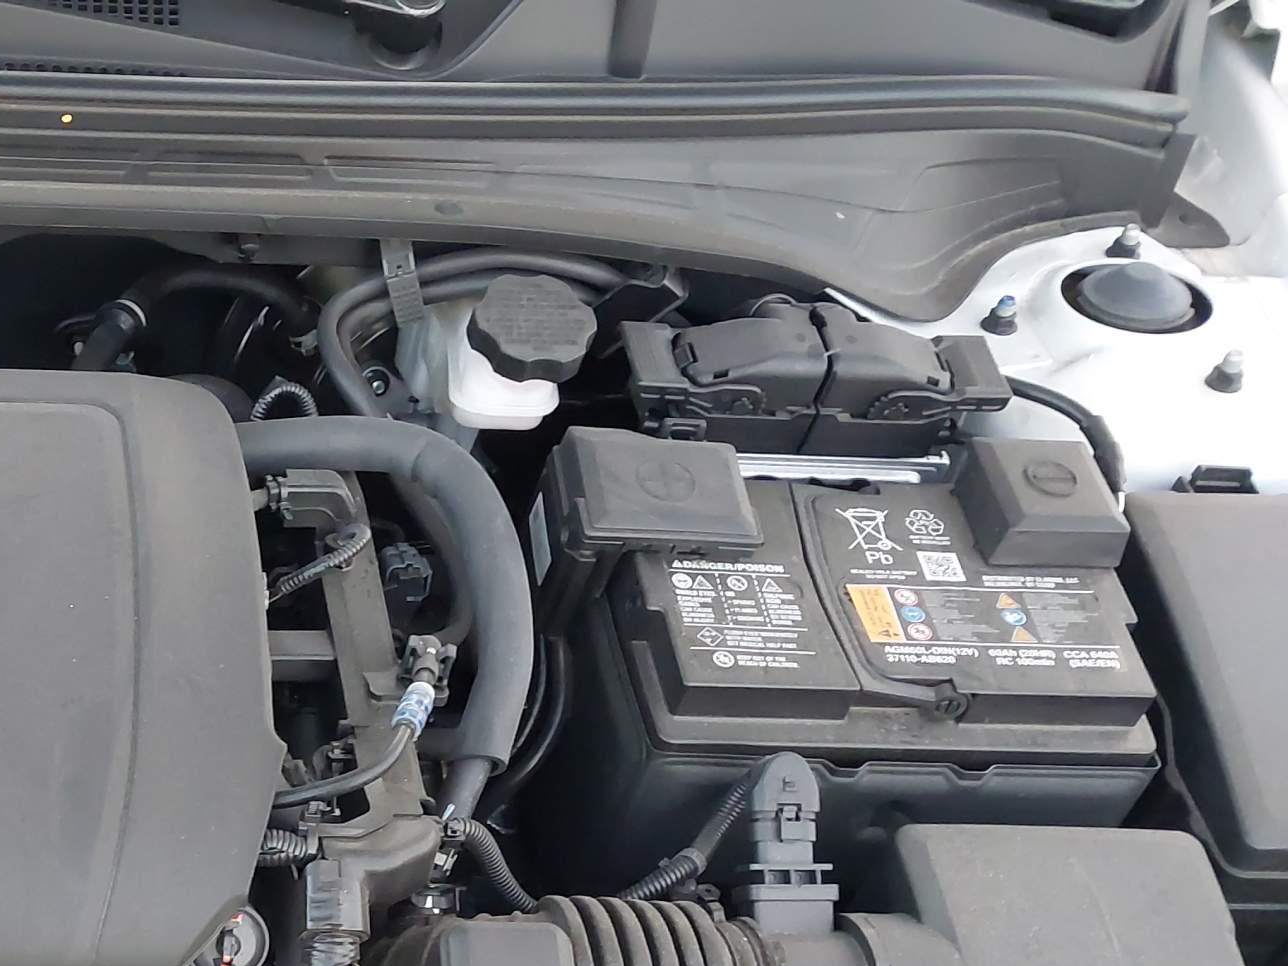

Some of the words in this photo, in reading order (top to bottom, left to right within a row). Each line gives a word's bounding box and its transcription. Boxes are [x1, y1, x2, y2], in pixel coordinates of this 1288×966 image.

[865, 550, 893, 564] Pb
[1063, 650, 1089, 658] CCA
[996, 657, 1014, 666] RC
